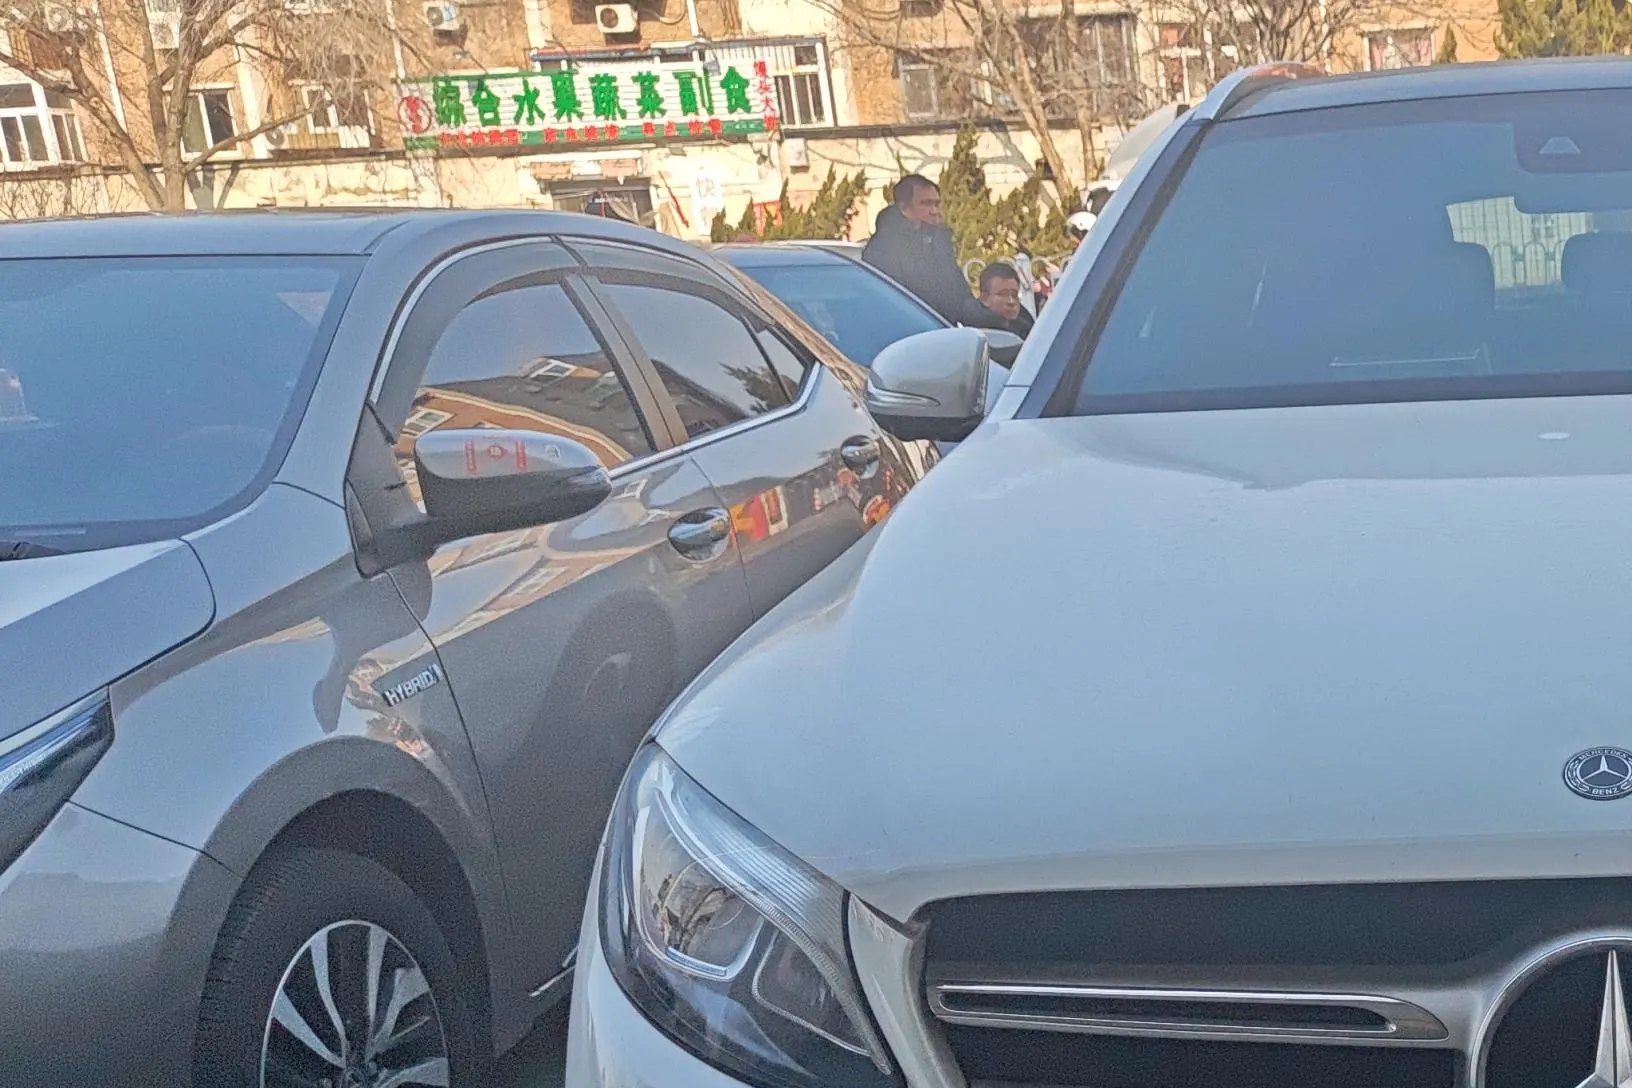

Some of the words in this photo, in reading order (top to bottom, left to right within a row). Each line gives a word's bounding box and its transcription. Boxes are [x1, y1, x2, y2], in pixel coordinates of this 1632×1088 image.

[433, 66, 752, 127] 综合水果蔬菜副食
[384, 669, 435, 706] HYBRID
[1591, 787, 1620, 796] BENZ
